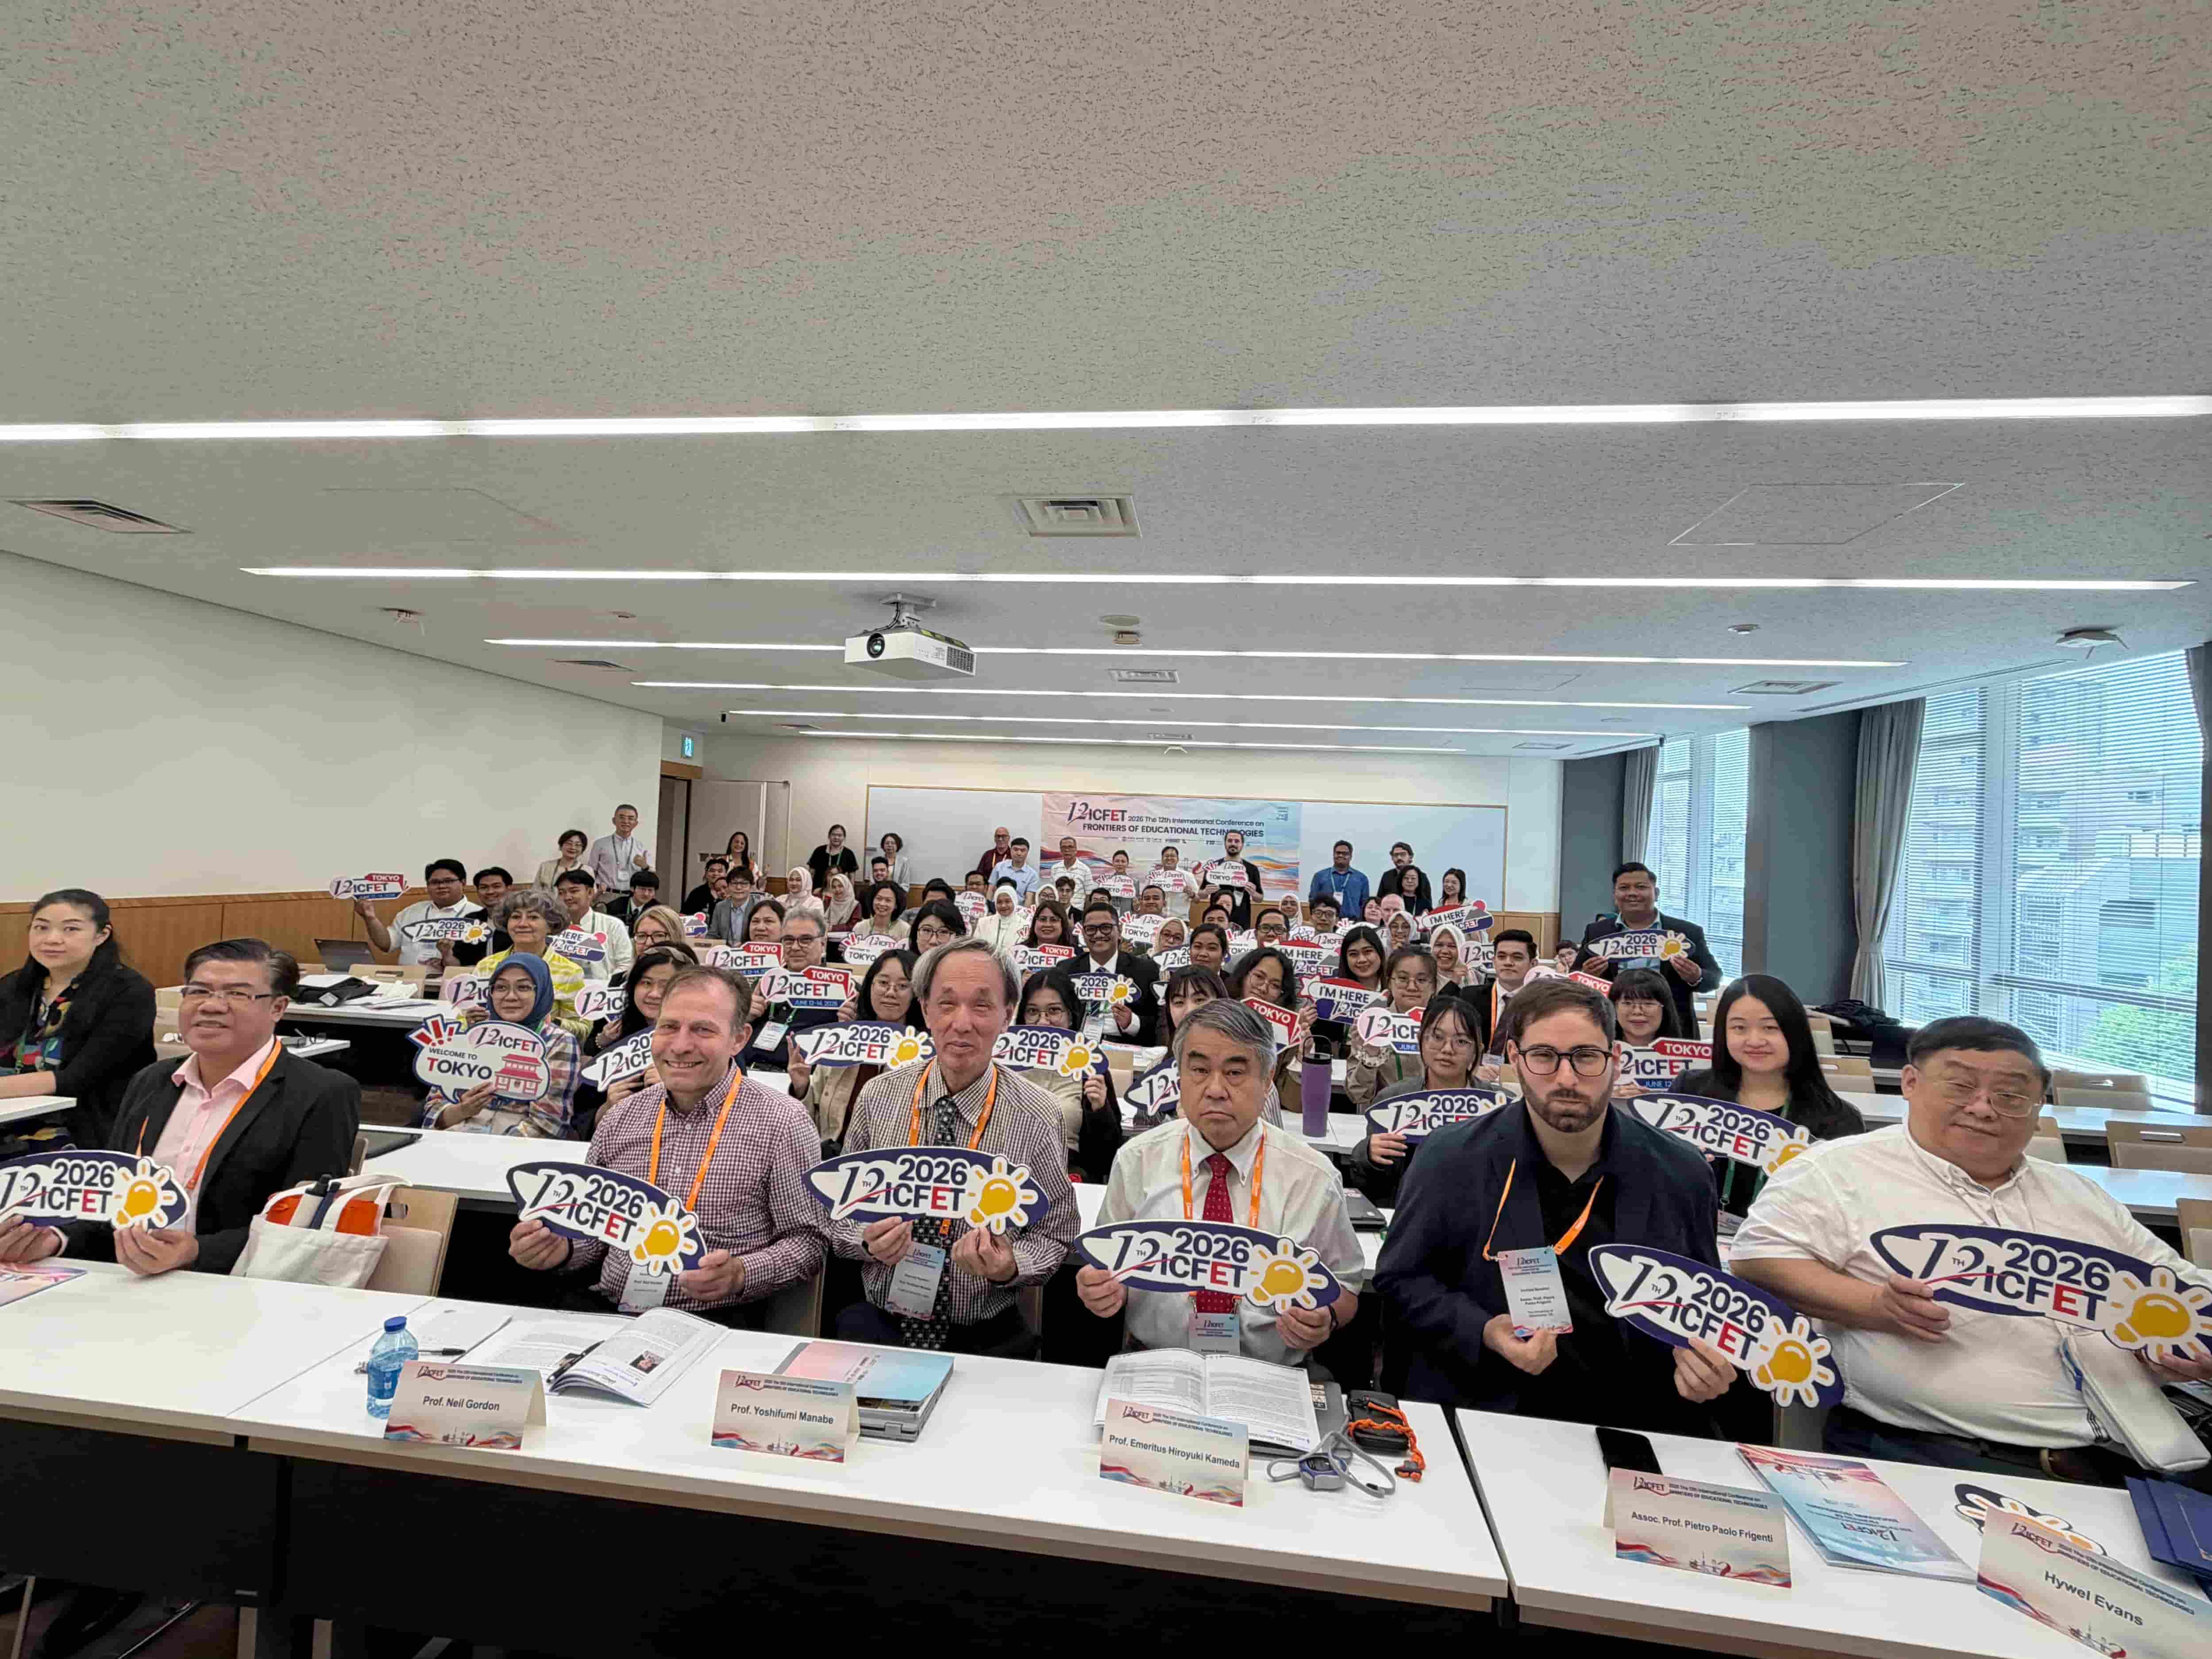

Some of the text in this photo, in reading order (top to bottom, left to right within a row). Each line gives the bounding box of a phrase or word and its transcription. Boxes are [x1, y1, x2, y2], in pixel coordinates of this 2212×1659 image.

[1089, 808, 1127, 822] ICFET
[1172, 817, 1214, 825] International
[1215, 818, 1253, 827] Conference
[1083, 823, 1126, 832] FRONTIERS
[1141, 826, 1198, 835] EDUCATIONAL
[1200, 828, 1264, 837] TECHNOGIES
[354, 883, 388, 893] ICFET
[1429, 909, 1467, 924] I'M HERE
[1125, 928, 1150, 938] TOKYO
[1626, 934, 1657, 944] 2026
[749, 944, 778, 953] TOKYO
[849, 951, 876, 962] TOKYO
[1044, 947, 1070, 955] TOKYO
[1296, 949, 1323, 960] HERE
[1621, 945, 1657, 956] ICFET
[730, 955, 766, 967] ICFET
[1306, 964, 1333, 974] ICFET
[810, 970, 844, 982] TOKYO
[1081, 977, 1109, 987] 2026
[1577, 975, 1608, 992] TOKYO
[789, 983, 831, 996] ICFET
[1076, 987, 1108, 998] ICFET
[1319, 985, 1370, 1003] I'M HERE
[1253, 1002, 1291, 1024] TOKYO
[848, 1026, 891, 1044] 2026
[1018, 1031, 1060, 1050] 2026
[1392, 1024, 1421, 1039] ICF
[498, 1035, 539, 1053] ICFET
[630, 1034, 652, 1053] 20
[839, 1040, 889, 1059] ICFET
[1664, 1043, 1711, 1056] TOKYO
[429, 1047, 465, 1059] WELCOME
[624, 1048, 652, 1070] ICF
[1009, 1046, 1059, 1066] ICFET
[427, 1056, 493, 1080] TOKYO
[1634, 1059, 1693, 1075] ICFET
[1429, 1096, 1480, 1114] 2026
[1422, 1113, 1469, 1130] ICF
[1707, 1107, 1770, 1141] 2026
[1692, 1122, 1767, 1160] ICFET
[53, 1161, 115, 1188] 2026
[898, 1158, 968, 1185] 2026
[40, 1186, 113, 1214] ICFET
[586, 1178, 644, 1218] 2026
[884, 1185, 966, 1212] ICFET
[566, 1197, 637, 1243] ICFET
[1175, 1231, 1250, 1264] 2026
[1161, 1252, 1248, 1287] ICFET
[2004, 1242, 2111, 1293] 2026
[1983, 1265, 2108, 1322] ICFET
[1691, 1277, 1767, 1334] 2026
[1669, 1296, 1758, 1362] ICFET
[423, 1396, 500, 1411] Prof. Neil Gordon
[731, 1403, 834, 1424] Prof. Yoshifumi Manabe
[1109, 1434, 1240, 1468] Prof. Emeritus Hiroyuki Kameda
[1631, 1511, 1773, 1543] Assoc. Prof. Pietro Paolo Frigenti
[2044, 1570, 2144, 1626] Hywel Evans
